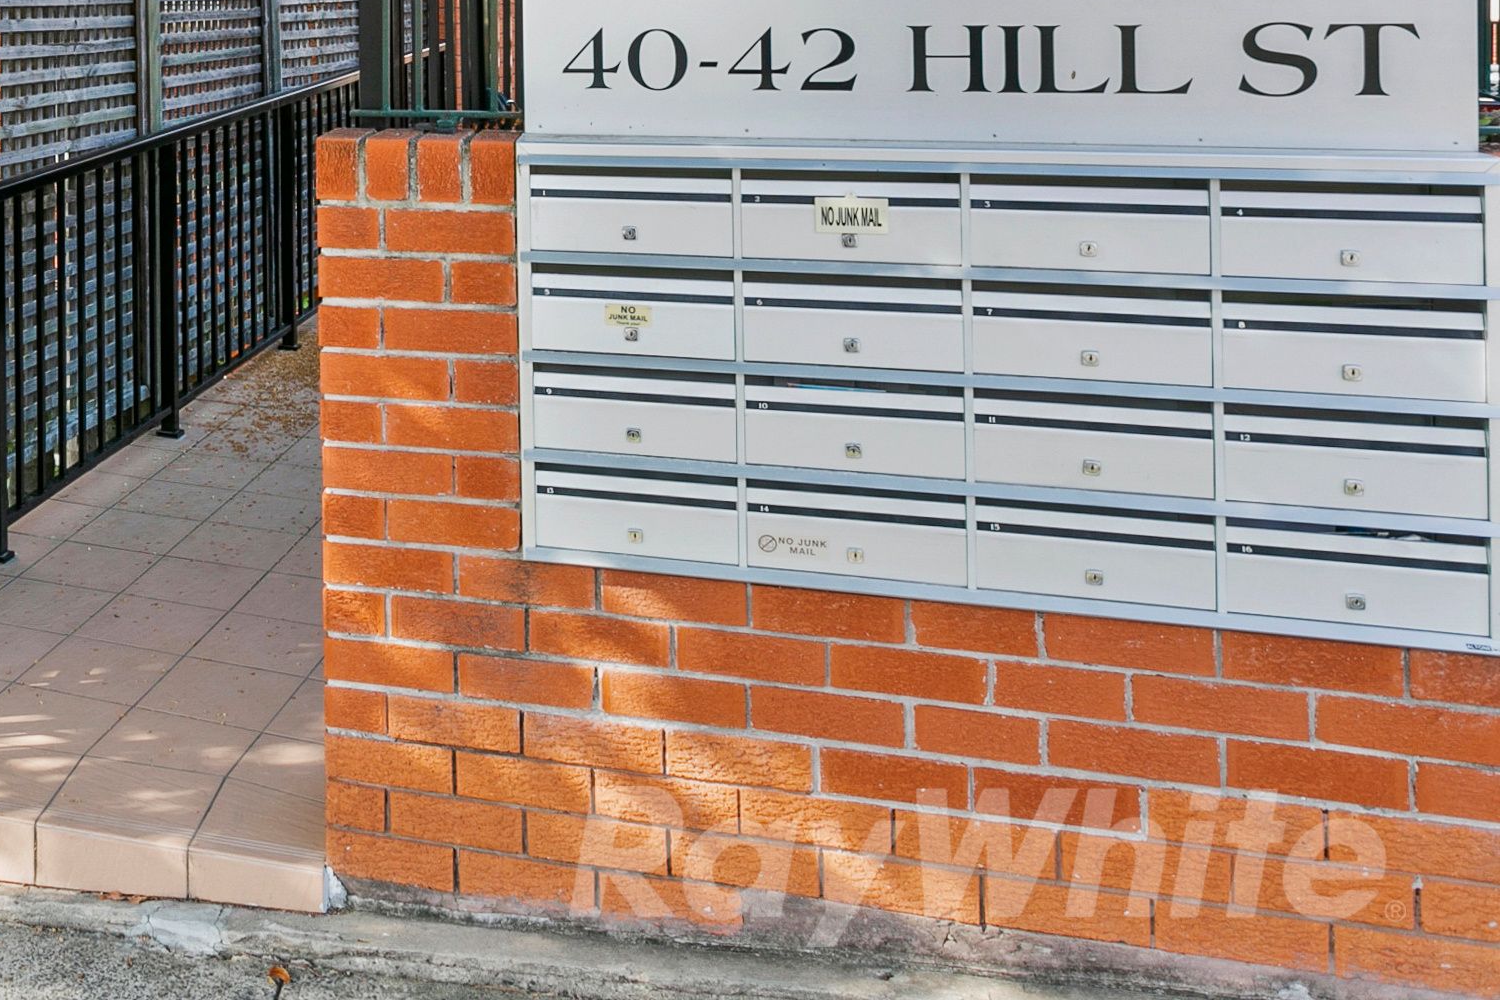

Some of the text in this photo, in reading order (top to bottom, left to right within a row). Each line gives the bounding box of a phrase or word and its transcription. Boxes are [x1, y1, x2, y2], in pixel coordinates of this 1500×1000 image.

[562, 21, 1421, 98] 40-42 HILL ST
[754, 195, 761, 203] 2
[984, 200, 991, 208] 3
[1236, 208, 1244, 216] 4
[821, 206, 882, 227] NO JUNK MAIL
[756, 298, 763, 306] 6
[620, 305, 636, 314] NO
[608, 313, 648, 322] JUNK MAIL
[546, 387, 553, 395] 9
[758, 402, 768, 410] 10
[1240, 434, 1251, 442] 12
[990, 523, 1000, 531] 15
[778, 537, 827, 548] NO JUNK
[789, 546, 816, 556] MAIL
[1242, 545, 1253, 553] 16
